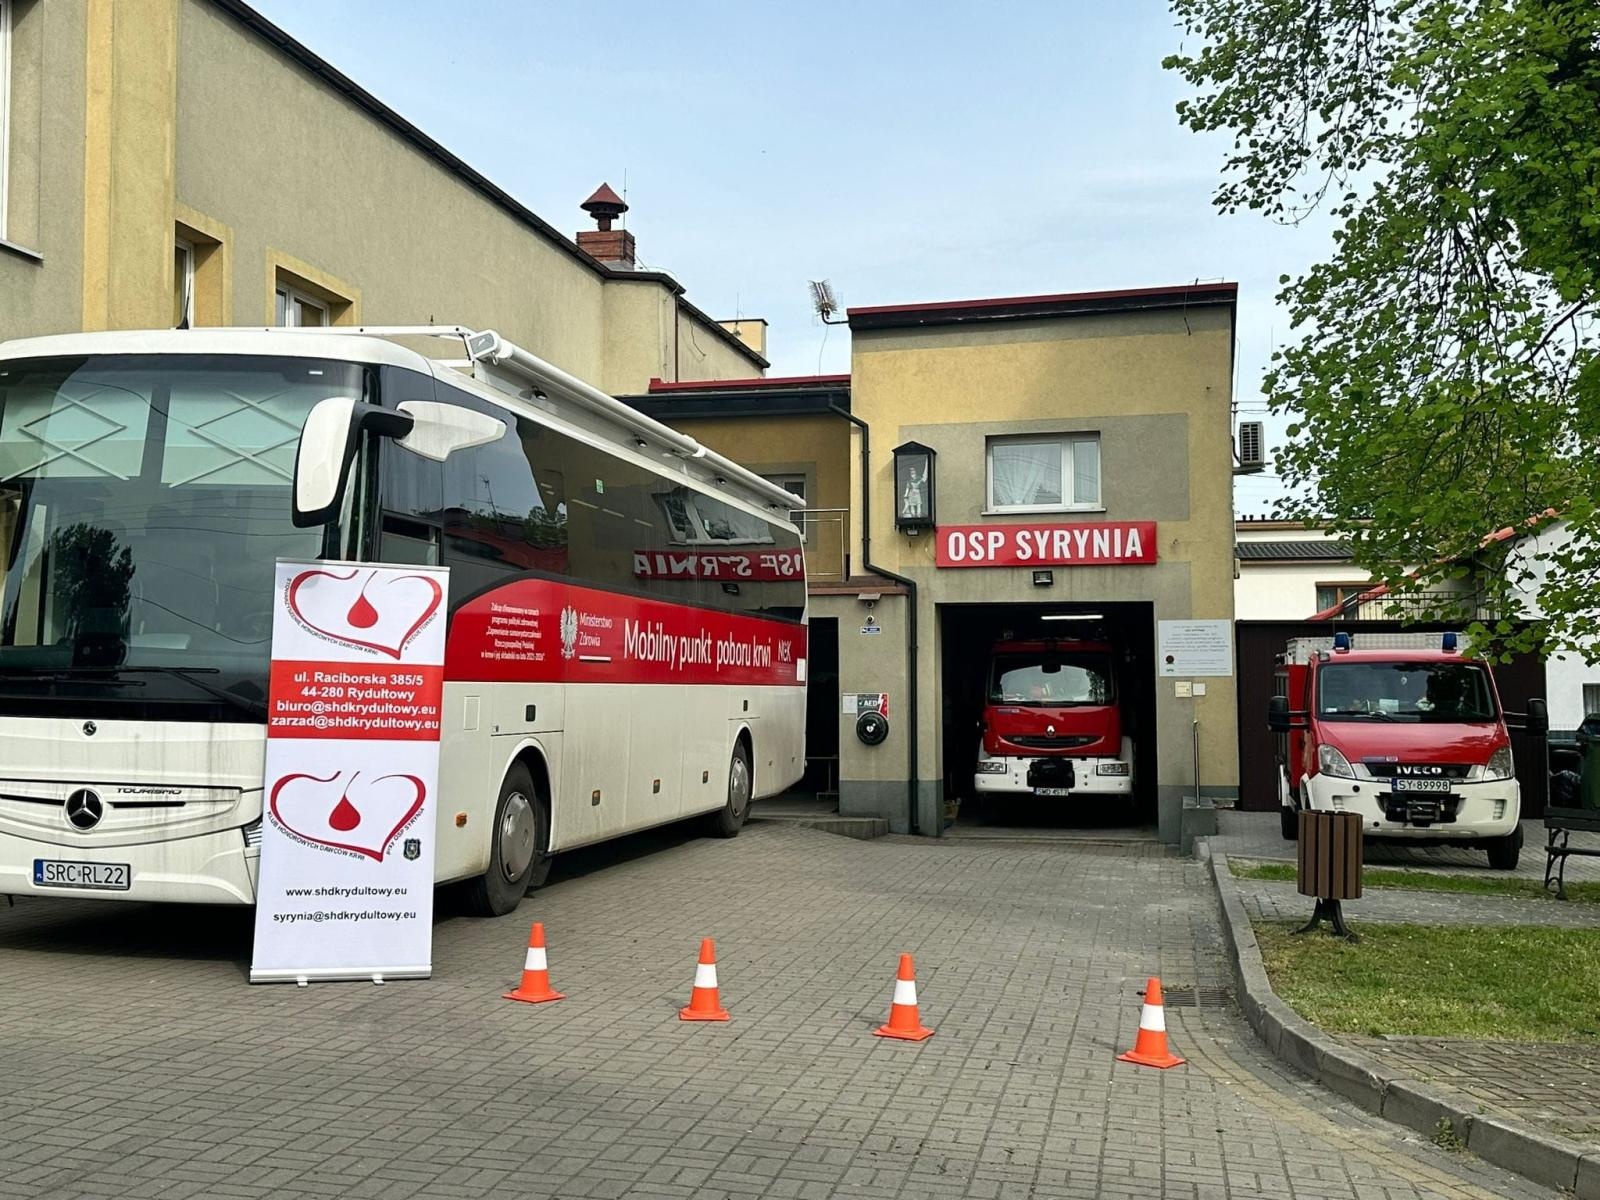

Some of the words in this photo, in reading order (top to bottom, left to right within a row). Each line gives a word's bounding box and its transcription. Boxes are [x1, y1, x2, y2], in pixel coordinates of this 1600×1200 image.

[948, 531, 1005, 561] OSP
[1015, 527, 1144, 560] SYRYNIA
[579, 612, 613, 629] Ministerstwo
[579, 631, 601, 647] Zdrowia
[624, 618, 678, 671] Mobilny
[679, 627, 713, 672] punkt
[716, 632, 752, 672] poboru
[753, 635, 771, 668] krwi
[294, 672, 310, 683] ul.
[314, 672, 387, 685] Raciborska
[390, 675, 424, 686] 385/5
[301, 686, 344, 698] 44-280
[347, 688, 415, 702] Rydułtowy
[276, 700, 437, 715] biuro@shdkrydultowy.eu
[271, 716, 439, 730] zarzad@shdkrydultowy.eu
[1396, 766, 1442, 775] IVECO
[117, 787, 182, 795] TOURISMO
[1399, 780, 1413, 790] SY
[1416, 780, 1448, 791] 89998
[267, 811, 279, 828] KLUB
[277, 826, 320, 849] HONOROWYCH
[349, 852, 366, 862] KRWI
[46, 864, 76, 882] SRC
[82, 866, 124, 884] RL22
[286, 886, 407, 898] www.shdkrydultowy.eu
[273, 910, 417, 923] syrynia@shdkrydultowy.eu
